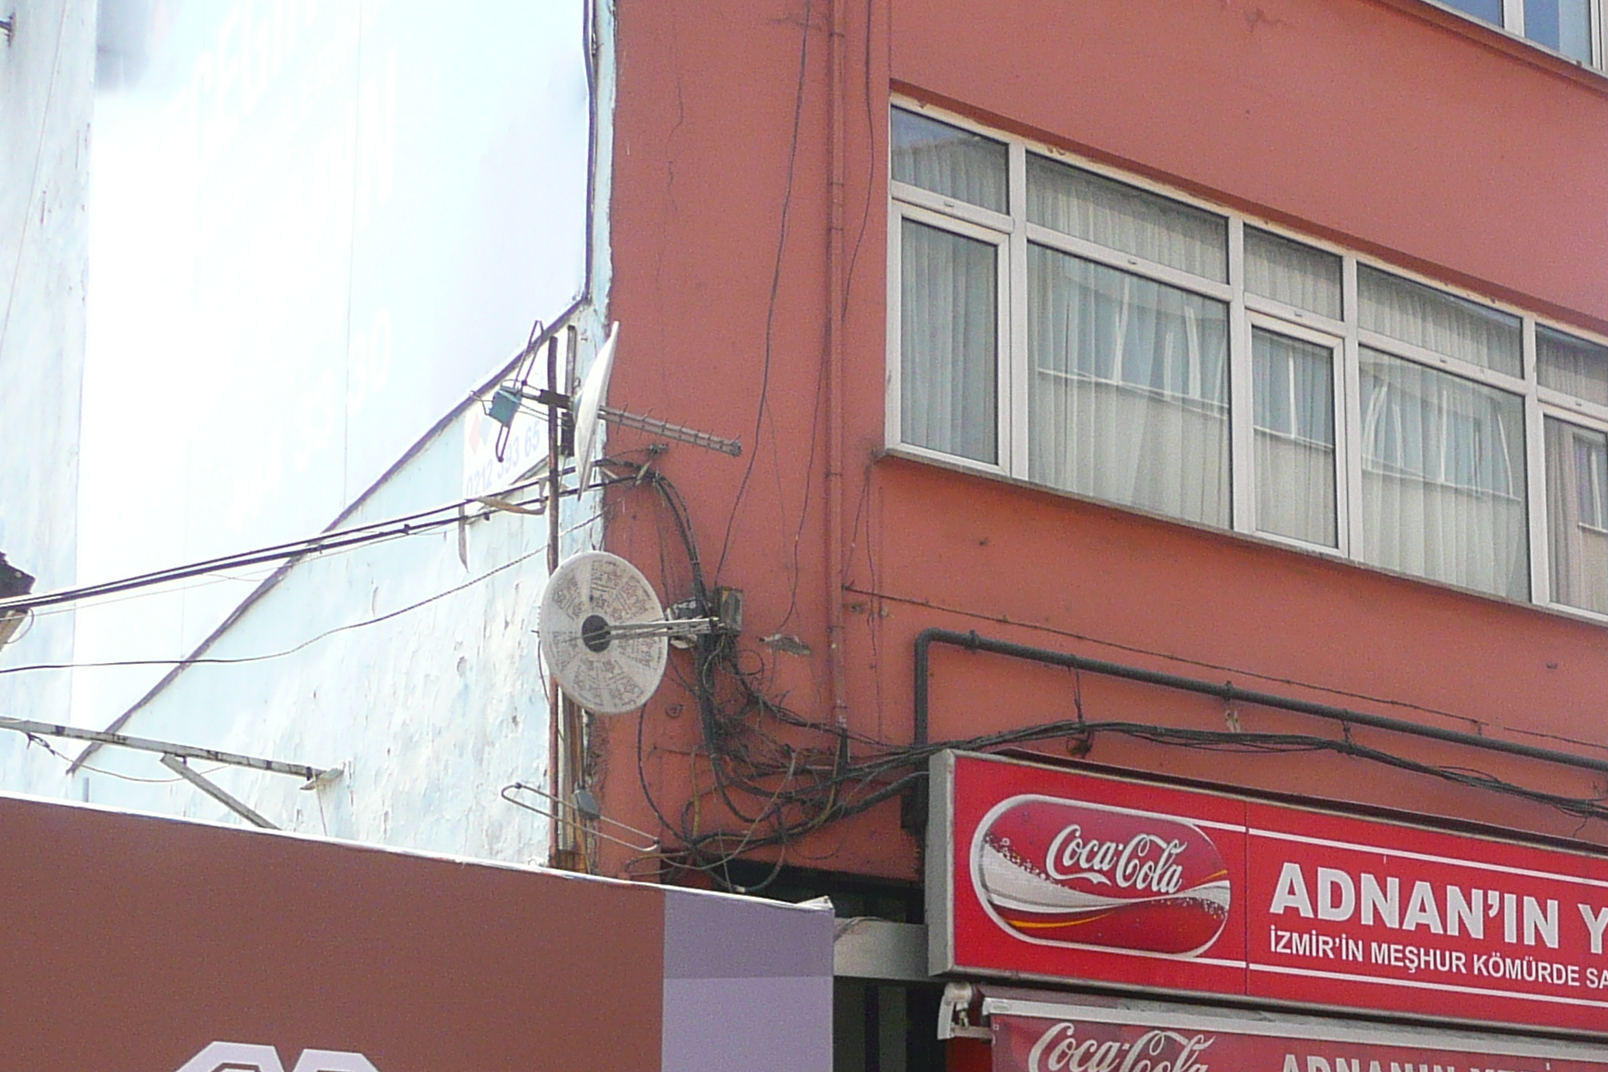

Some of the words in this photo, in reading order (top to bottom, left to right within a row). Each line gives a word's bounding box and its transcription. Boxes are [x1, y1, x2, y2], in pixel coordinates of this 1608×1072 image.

[1046, 824, 1187, 893] Coca-Cola
[1269, 862, 1559, 949] ADNAN'IN
[1270, 924, 1363, 962] İZMİR'İN
[1371, 942, 1467, 973] MEŞHUR
[1473, 952, 1580, 987] KÖMÜRDE
